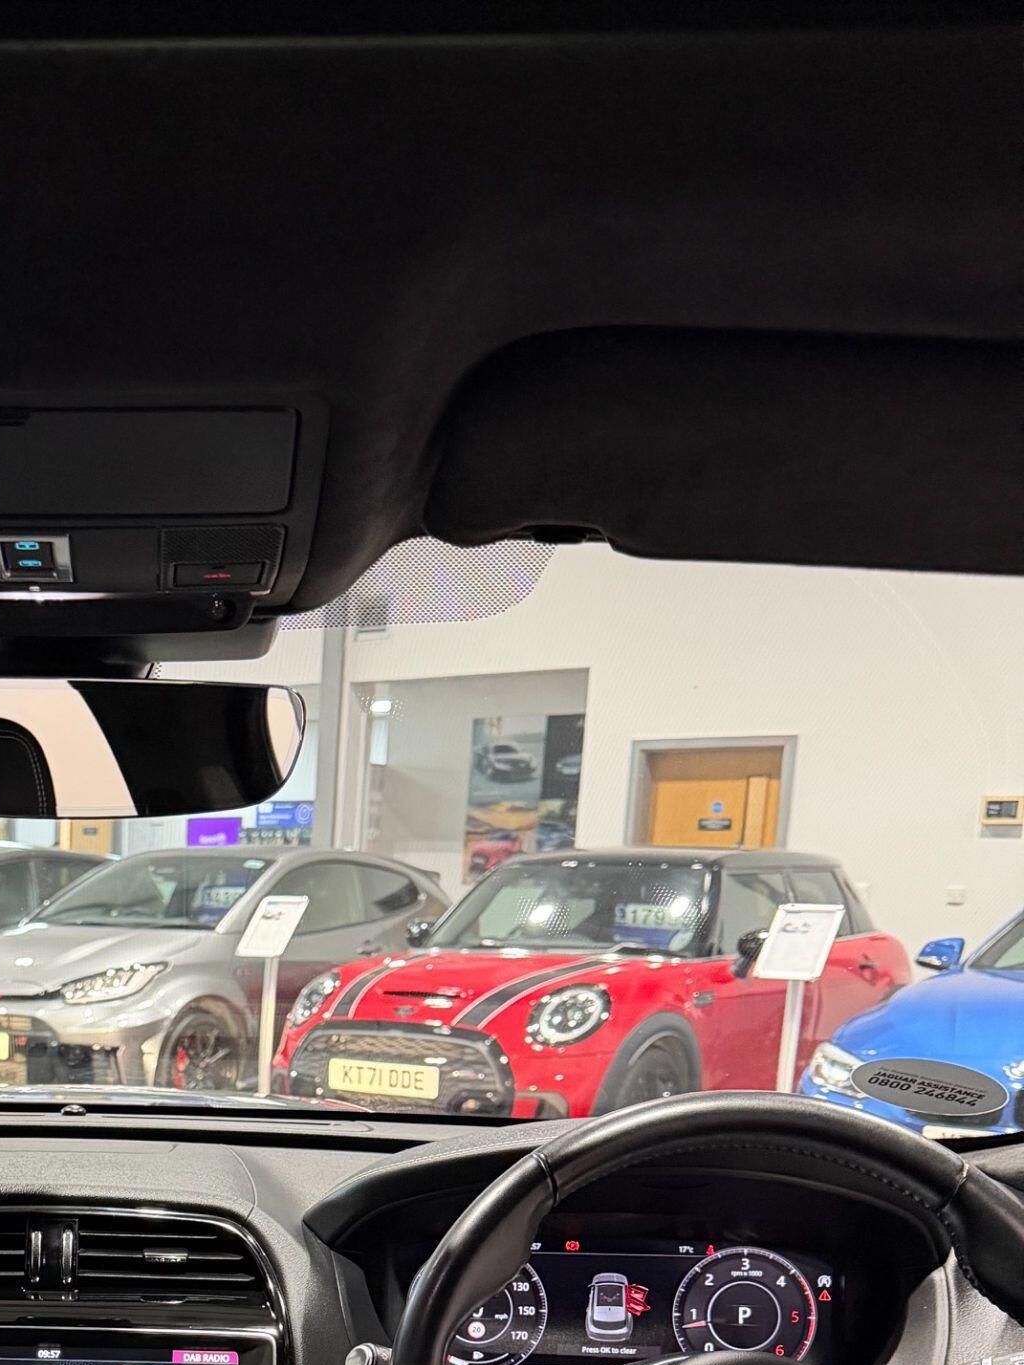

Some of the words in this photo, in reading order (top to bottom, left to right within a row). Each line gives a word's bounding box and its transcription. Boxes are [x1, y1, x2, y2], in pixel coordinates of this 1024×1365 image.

[342, 1064, 383, 1087] KT71
[873, 1071, 918, 1084] JAGUAR
[917, 1080, 986, 1100] ASSISTANCE
[867, 1076, 912, 1092] 0800
[913, 1086, 979, 1107] 246844
[740, 1259, 751, 1271] 3
[704, 1274, 714, 1286] 2
[776, 1276, 787, 1287] 4
[512, 1282, 530, 1292] 130
[517, 1306, 536, 1315] 150
[689, 1309, 697, 1320] 1
[738, 1306, 752, 1325] P
[791, 1311, 800, 1322] 5
[510, 1331, 529, 1340] 170
[38, 1350, 61, 1359] 09:57
[581, 1346, 599, 1354] Press
[619, 1347, 637, 1355] clear
[775, 1344, 785, 1357] 6
[183, 1353, 201, 1362] DAB
[202, 1354, 230, 1363] RADIO
